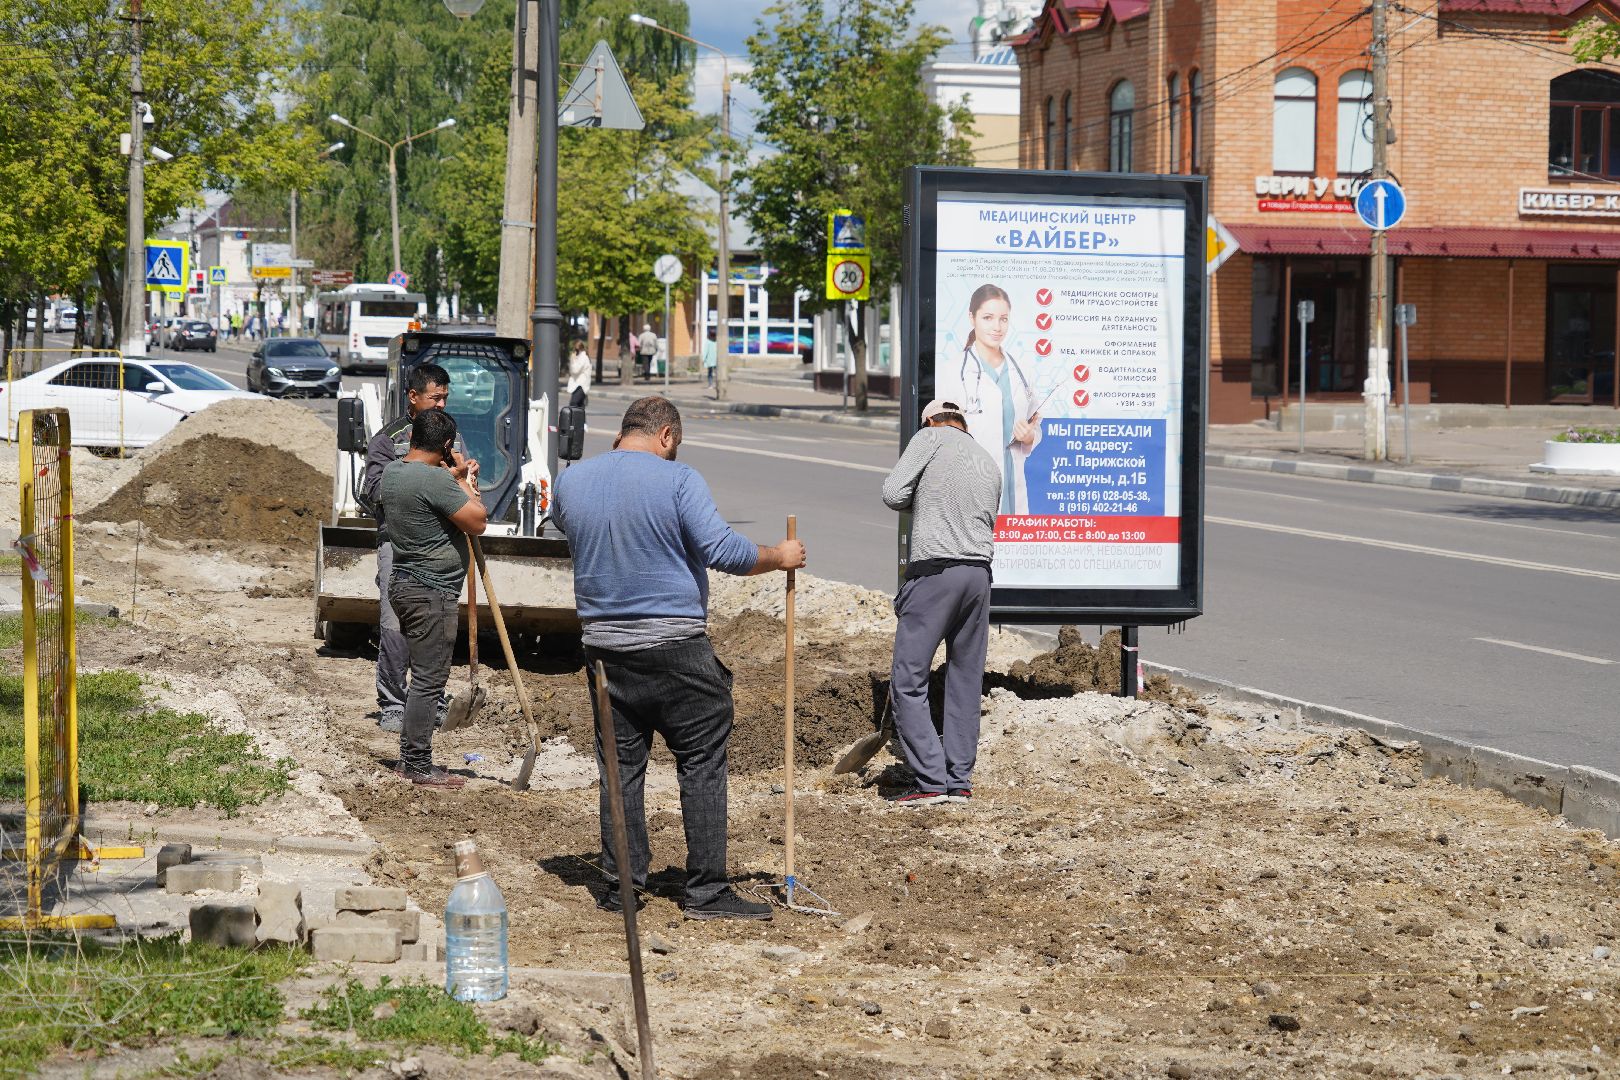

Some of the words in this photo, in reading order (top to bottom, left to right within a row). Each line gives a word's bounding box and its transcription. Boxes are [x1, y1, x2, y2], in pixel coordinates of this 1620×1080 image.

[1256, 176, 1309, 195] БЕРИ
[1313, 177, 1329, 197] У
[1525, 193, 1595, 209] КИБЕР
[979, 209, 1089, 225] МЕДИЦИНСКИЙ
[1094, 212, 1136, 226] ЦЕНТР
[995, 225, 1119, 250] «ВАЙБЕР»
[841, 271, 857, 284] 20
[1060, 290, 1118, 298] МЕДИЦИНСКИЕ
[1119, 291, 1159, 299] ОСМОТРЫ
[1070, 298, 1085, 306] ПРИ
[1087, 298, 1159, 307] ТРУДОУСТРОЙСТВЕ
[1055, 314, 1100, 322] КОМИССИЯ
[1114, 315, 1158, 323] ОХРАННУЮ
[1101, 324, 1158, 332] ДЕЯТЕЛЬНОСТЬ
[1104, 340, 1157, 348] ОФОРМЛЕНИЕ
[1080, 348, 1111, 356] КНИЖЕК
[1120, 349, 1157, 357] СПРАВОК
[1098, 366, 1157, 374] ВОДИТЕЛЬСКАЯ
[1113, 374, 1157, 383] КОМИССИЯ
[1092, 391, 1156, 399] ФЛЮОРОГРАФИЯ
[1048, 424, 1071, 438] МЫ
[1074, 424, 1152, 439] ПЕРЕЕХАЛИ
[1066, 441, 1082, 451] по
[1085, 440, 1133, 454] адресу:
[1052, 457, 1072, 470] ул.
[1075, 455, 1146, 470] Парижской
[1050, 471, 1114, 486] Коммуны,
[1118, 472, 1147, 487] д.1Б
[1077, 490, 1101, 502] (916)
[1103, 491, 1151, 503] 028-05-38,
[1059, 502, 1065, 512] 8
[1067, 502, 1090, 514] (916)
[1092, 502, 1138, 513] 402-21-46
[1006, 517, 1048, 528] ГРАФИК
[1050, 517, 1097, 529] РАБОТЫ:
[999, 531, 1021, 539] 8:00
[1022, 532, 1035, 540] до
[1036, 531, 1062, 541] 17:00,
[1063, 531, 1076, 540] СБ
[1085, 531, 1106, 540] 8:00
[1107, 533, 1120, 541] до
[1121, 532, 1146, 541] 13:00
[1097, 545, 1163, 558] НЕОБХОДИМО
[992, 558, 1066, 570] ЛЬТИРОВАТЬСЯ
[1069, 559, 1081, 570] СО
[1083, 559, 1162, 571] СПЕЦИАЛИСТОМ
